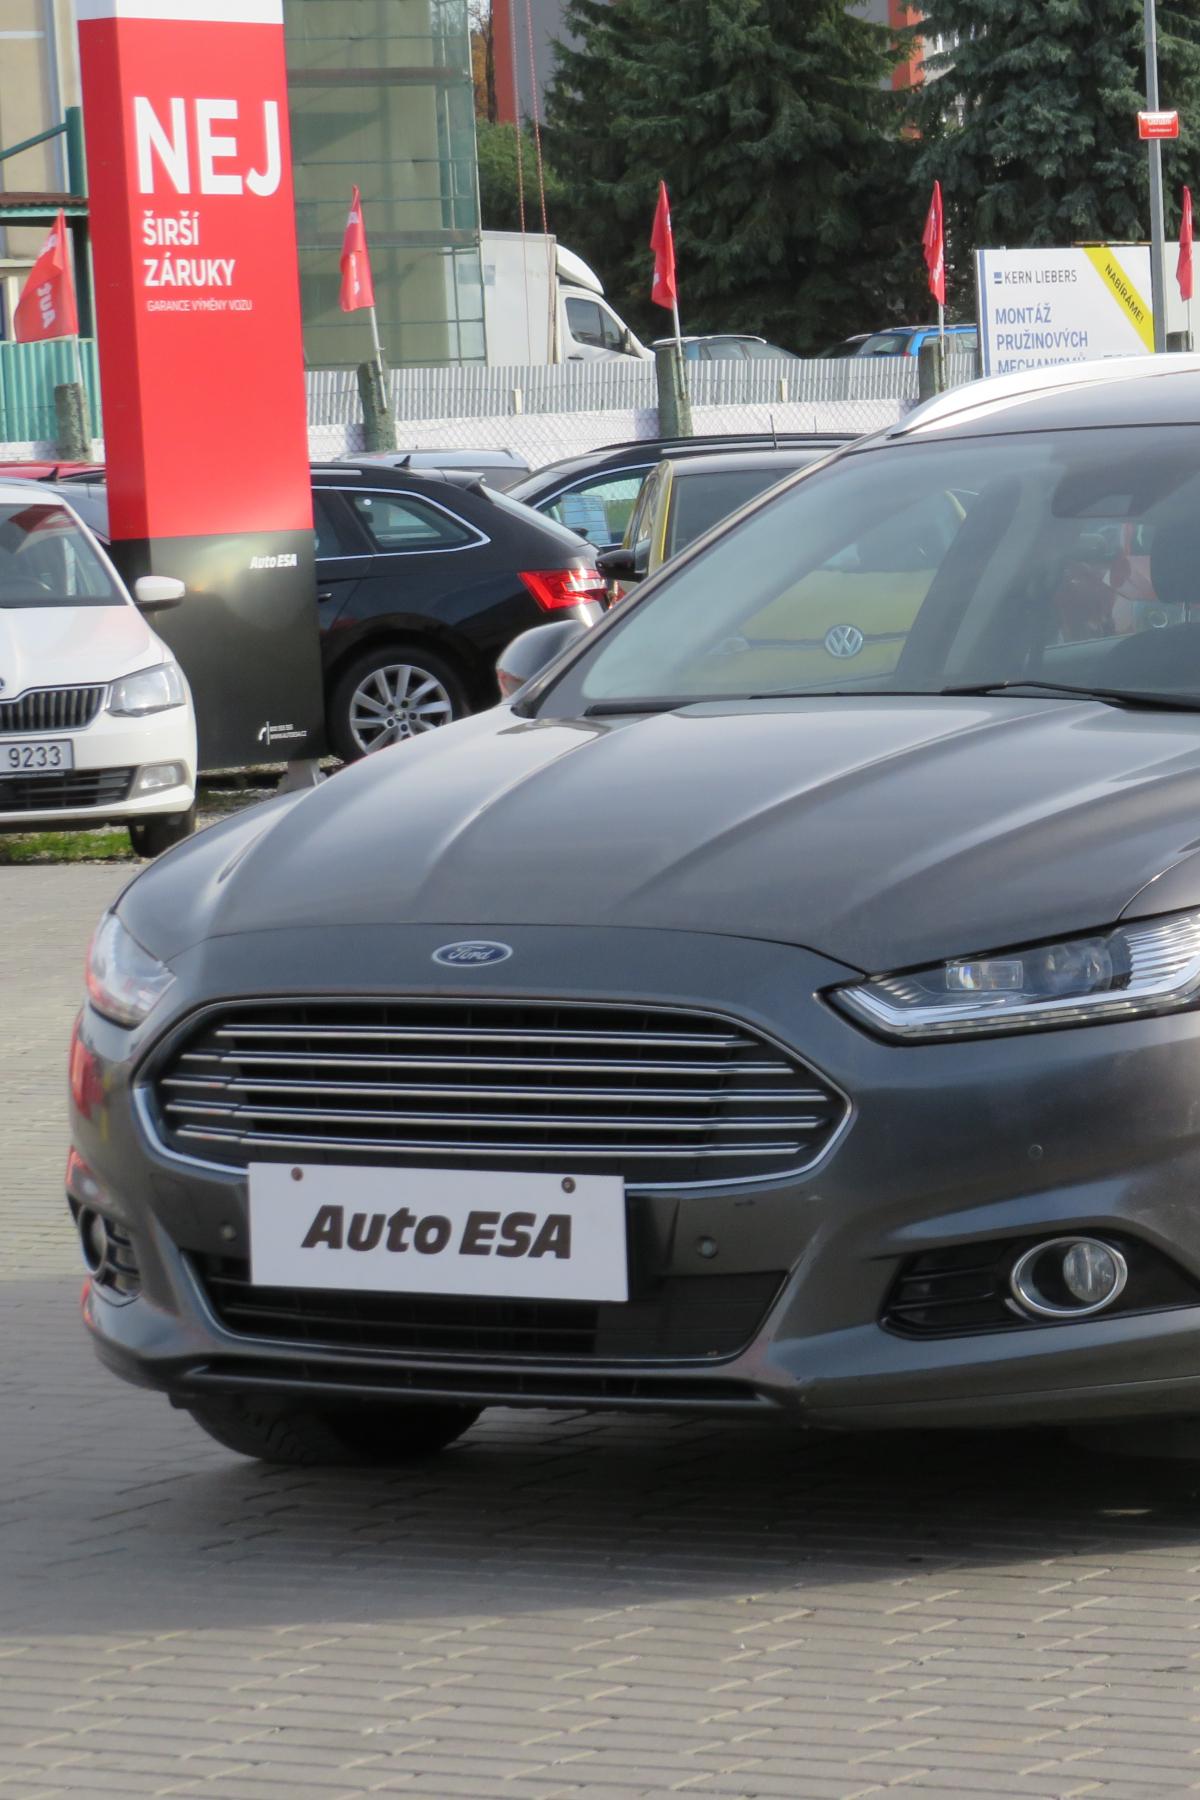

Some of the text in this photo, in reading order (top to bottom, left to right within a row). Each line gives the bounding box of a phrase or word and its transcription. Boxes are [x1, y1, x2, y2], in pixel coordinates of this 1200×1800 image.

[134, 96, 281, 197] NEJ
[143, 210, 200, 246] ŠIRŠÍ
[143, 251, 236, 287] ZÁRUKY
[1004, 269, 1078, 284] KERN LIEBERS
[147, 298, 252, 311] GARANCE VÝMĚNY VOZU
[1105, 263, 1145, 324] NABÍRÁME!
[995, 303, 1052, 325] MONTÁŽ
[997, 328, 1088, 351] PRUŽINOVÝCH
[250, 553, 298, 569] Auto ESA
[8, 745, 61, 769] 9233
[301, 1205, 571, 1259] Auto ESA
